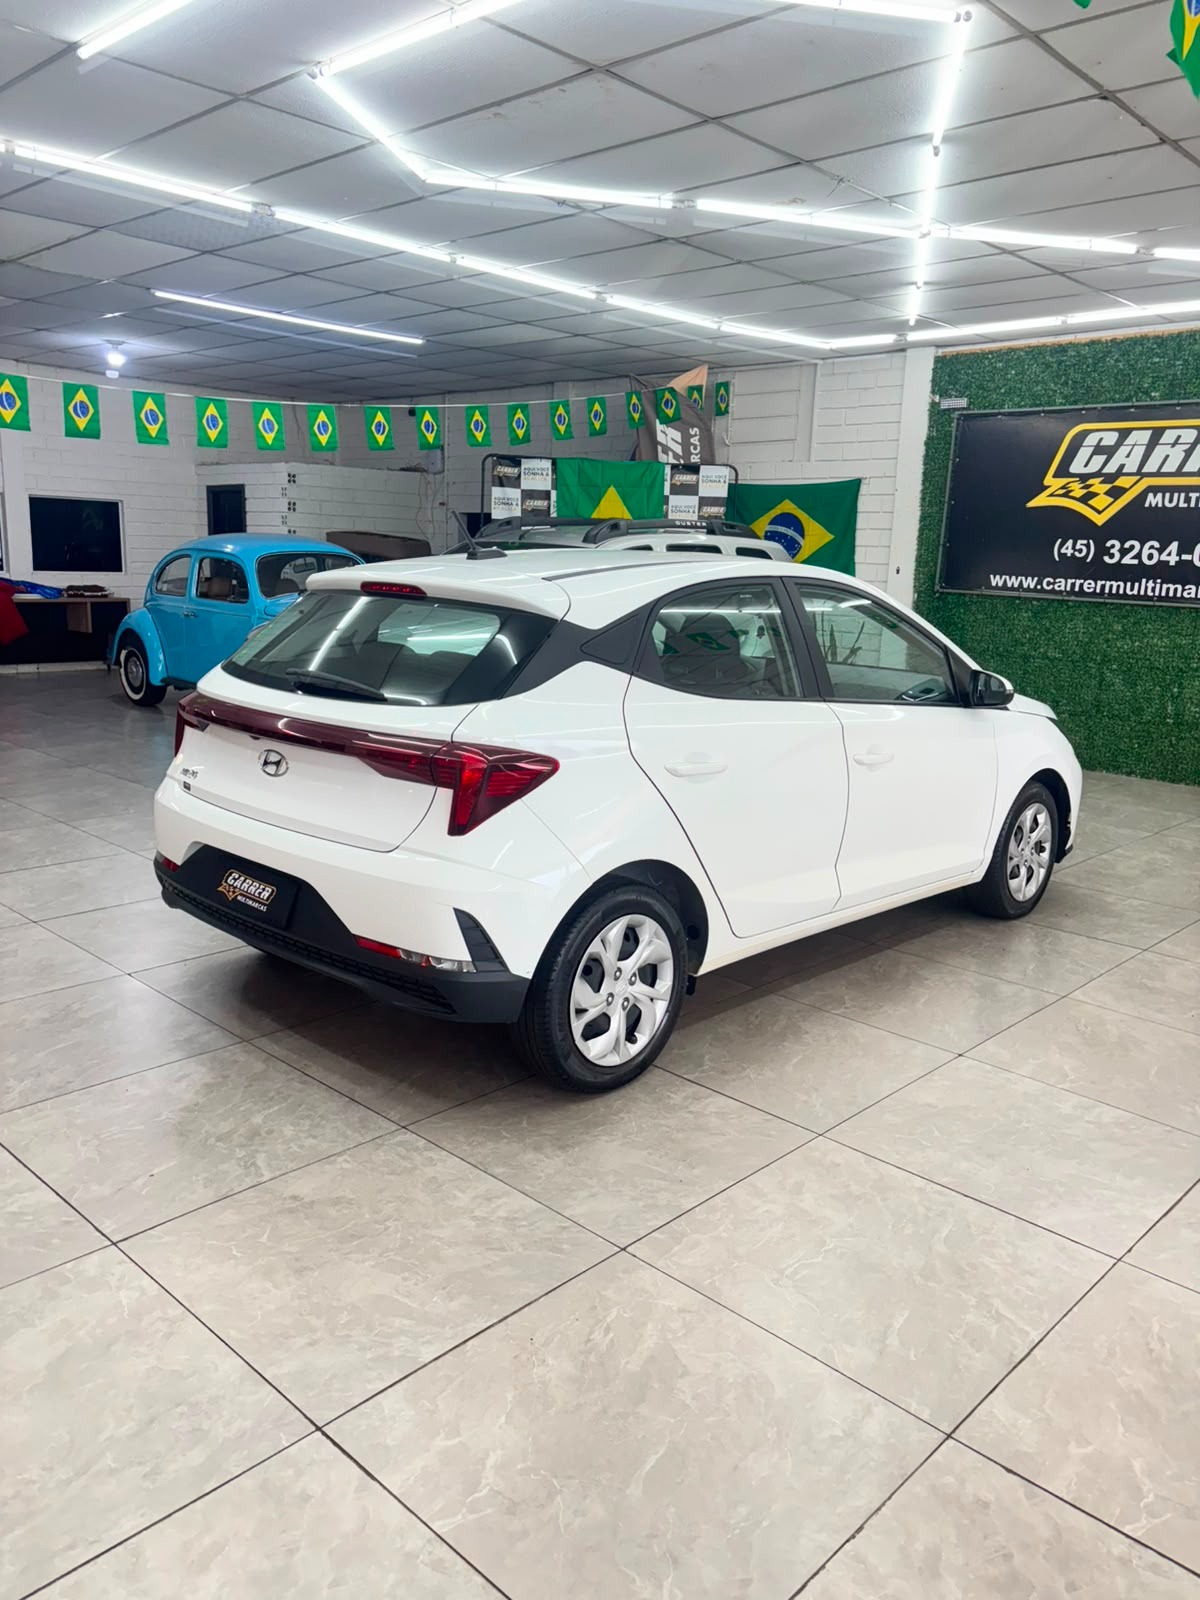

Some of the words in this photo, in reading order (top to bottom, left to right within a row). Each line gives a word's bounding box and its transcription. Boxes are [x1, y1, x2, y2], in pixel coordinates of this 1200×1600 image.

[689, 427, 701, 464] RCAS
[1053, 539, 1095, 562] (45)
[227, 872, 273, 901] CARRER
